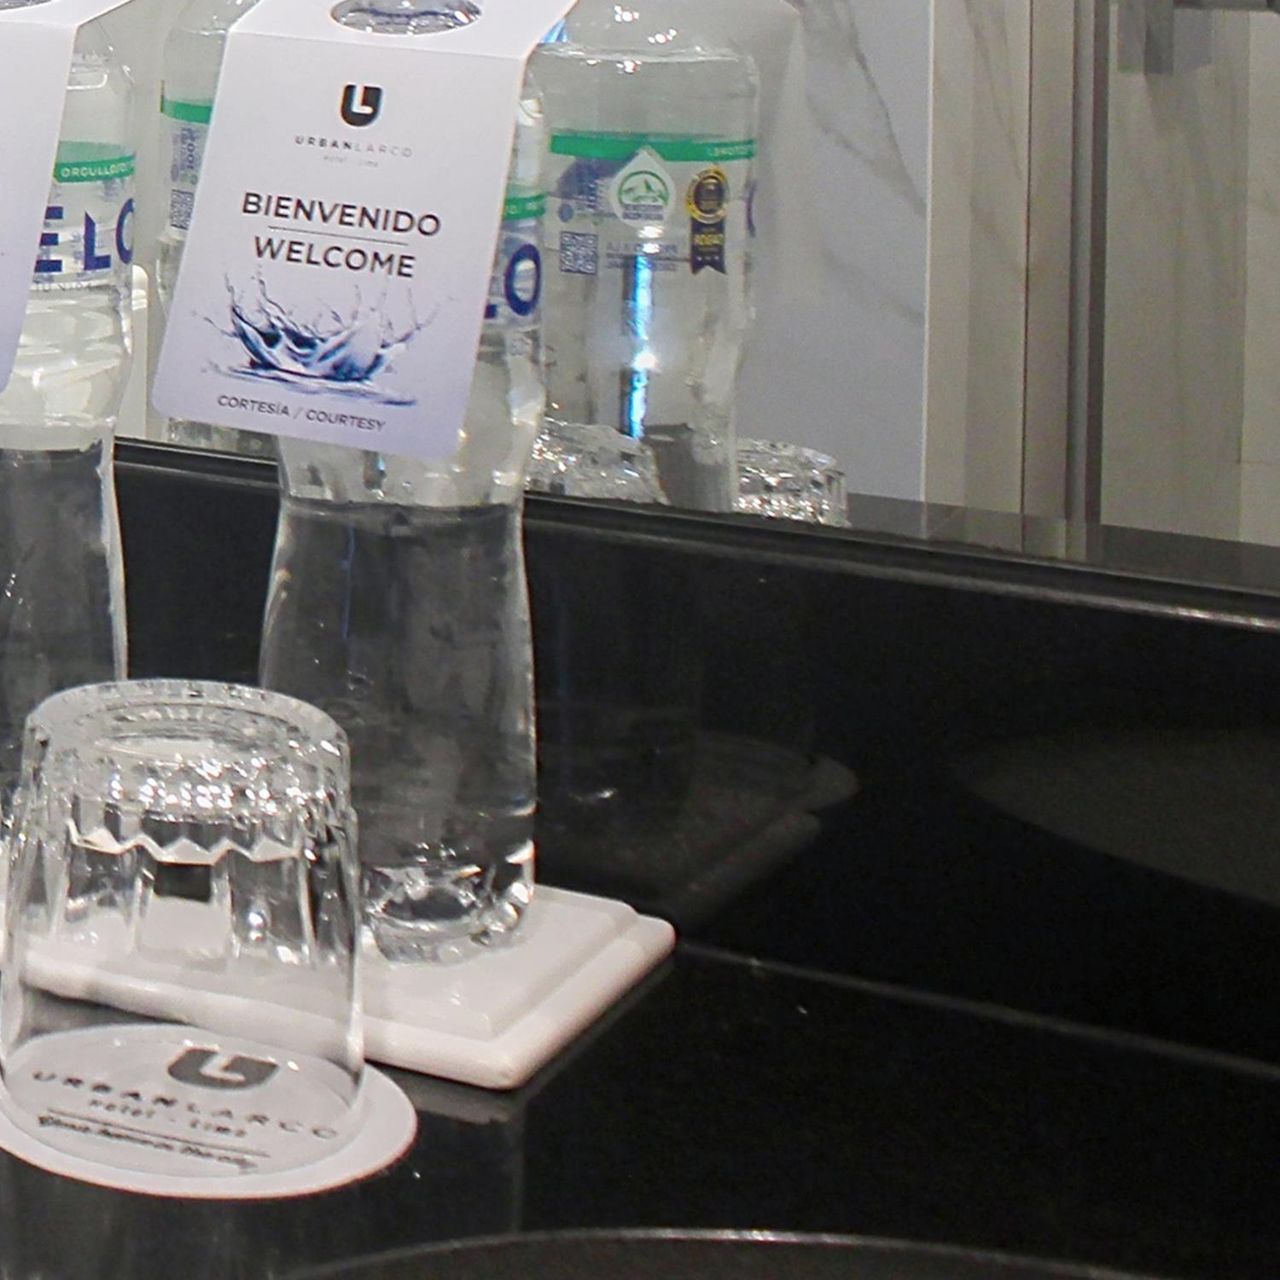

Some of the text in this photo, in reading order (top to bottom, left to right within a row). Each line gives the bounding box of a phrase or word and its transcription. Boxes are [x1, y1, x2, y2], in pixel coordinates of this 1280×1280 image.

[242, 192, 442, 236] BIENVENIDO
[254, 236, 416, 278] WELCOME
[218, 394, 290, 417] CORTESÍA
[305, 409, 386, 431] COURTESY
